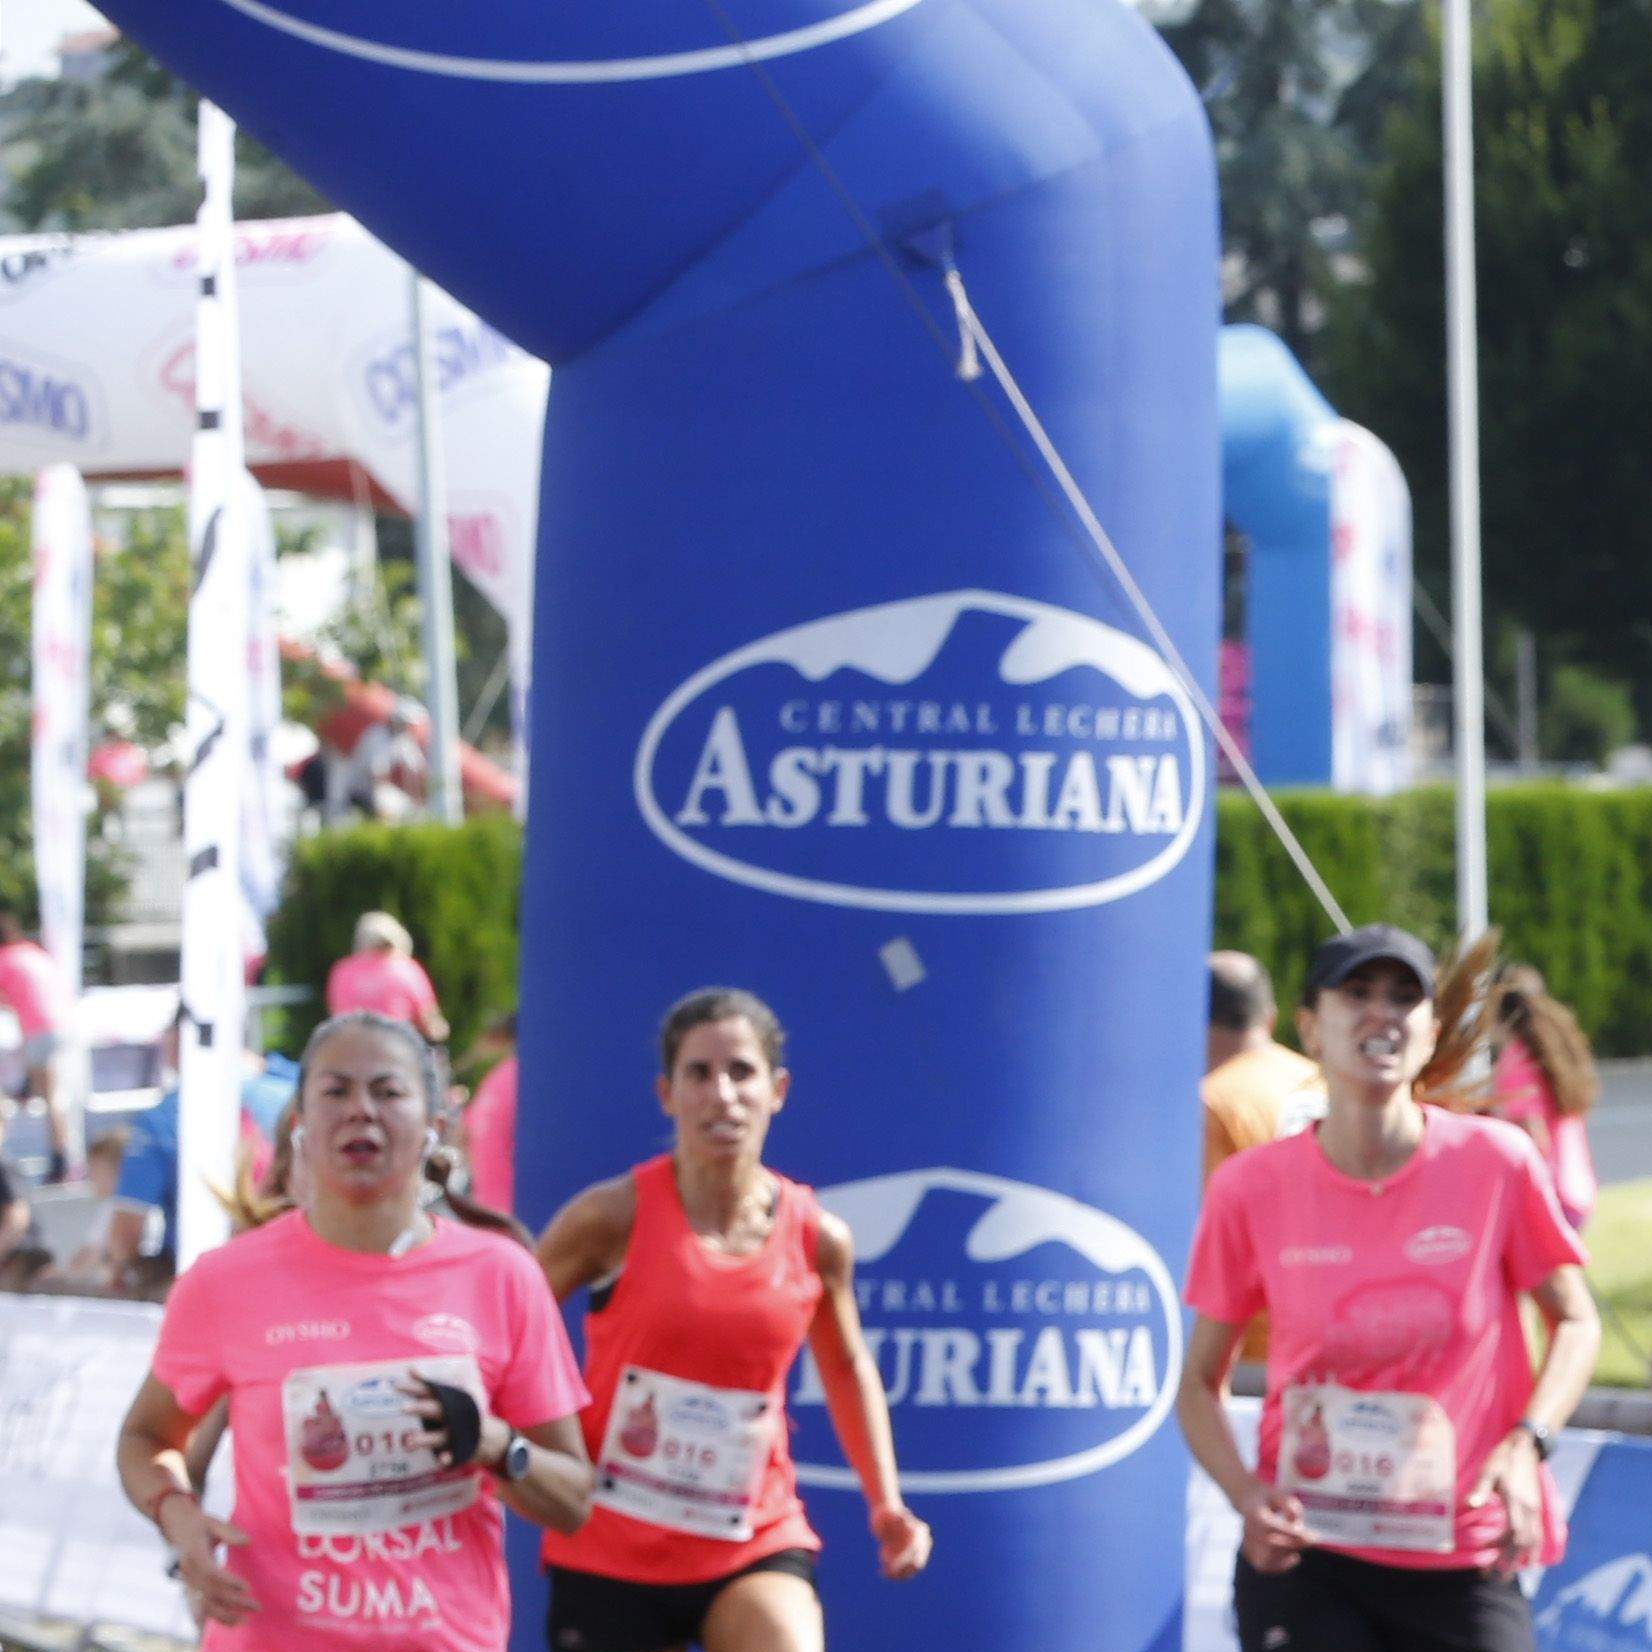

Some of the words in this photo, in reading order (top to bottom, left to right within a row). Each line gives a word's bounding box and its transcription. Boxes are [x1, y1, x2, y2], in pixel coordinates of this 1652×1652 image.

[779, 700, 998, 734] CENTRAL
[1016, 703, 1177, 741] LECHERA
[674, 705, 1185, 834] ASTURIANA
[856, 1279, 960, 1313] TRAL
[983, 1281, 1151, 1315] LECHERA
[795, 1326, 1160, 1408] URIANA
[296, 1568, 439, 1620] SUMA
